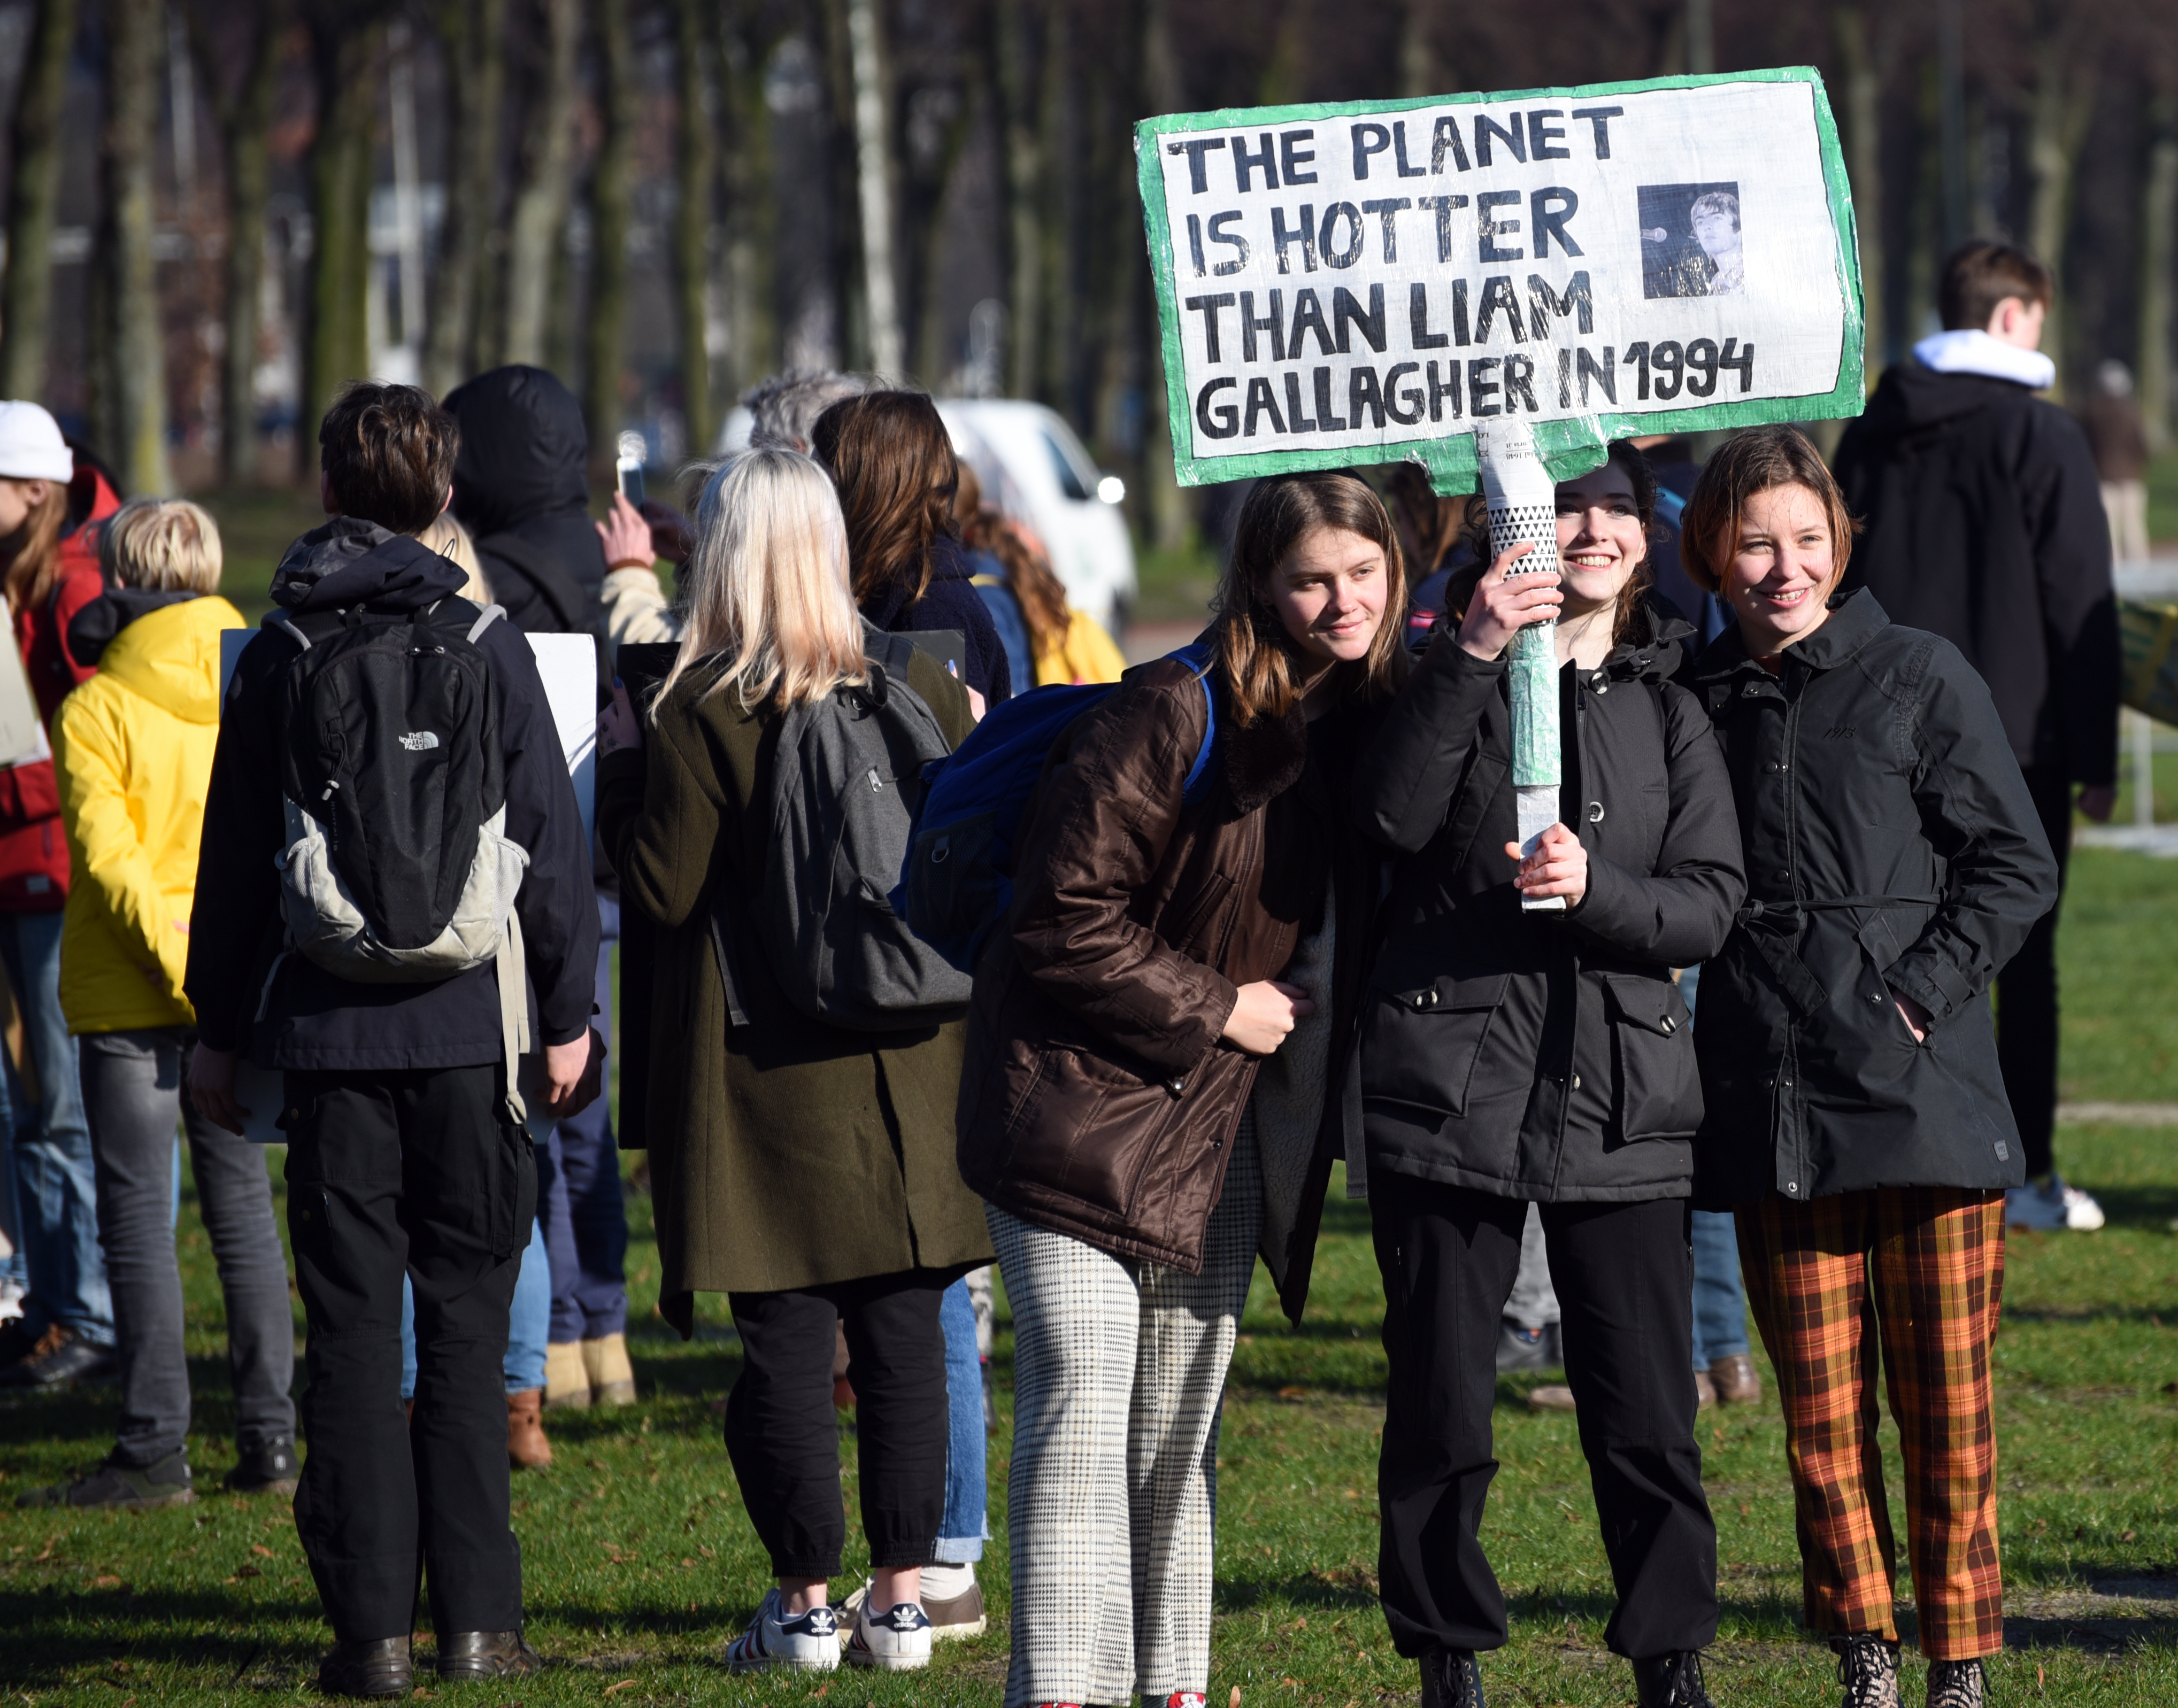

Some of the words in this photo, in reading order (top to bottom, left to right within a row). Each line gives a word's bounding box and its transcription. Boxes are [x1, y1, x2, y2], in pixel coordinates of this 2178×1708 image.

[1168, 129, 1319, 195] THE
[1351, 106, 1623, 181] PLANET
[1187, 210, 1250, 277] IS
[1272, 187, 1586, 275] HOTTER
[1186, 283, 1387, 364] THAN
[1410, 271, 1594, 350] LIAM
[1196, 354, 1540, 439] GALLAGHER
[1558, 346, 1618, 410] IN
[1623, 338, 1754, 400] 1994
[1823, 727, 1857, 738] 1913
